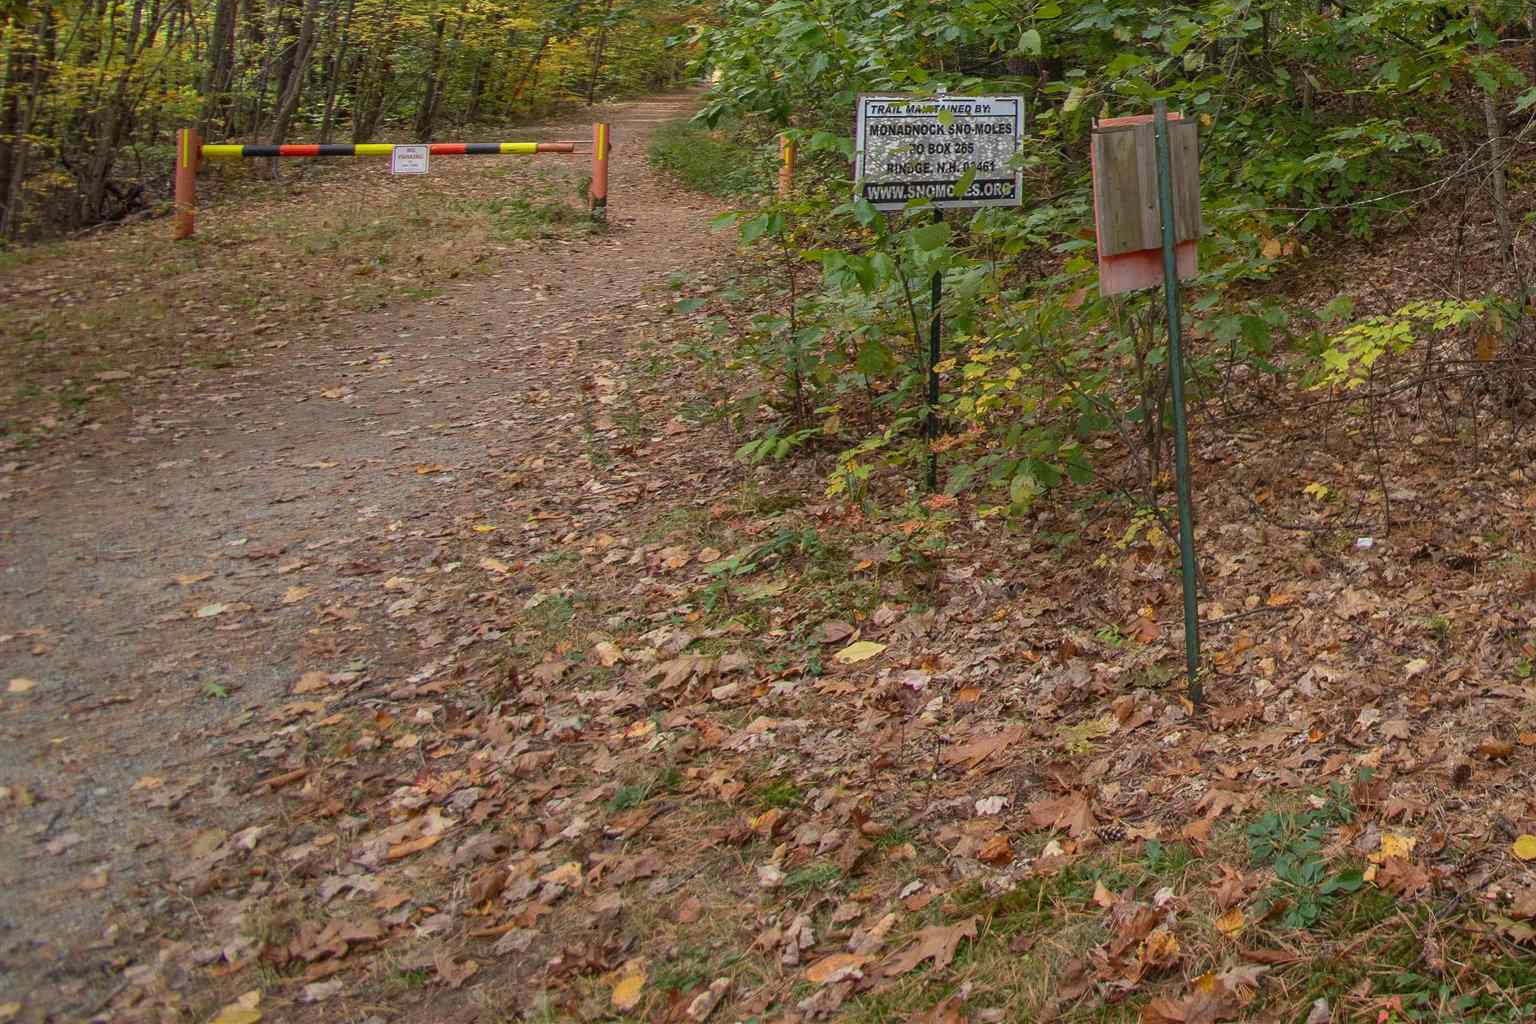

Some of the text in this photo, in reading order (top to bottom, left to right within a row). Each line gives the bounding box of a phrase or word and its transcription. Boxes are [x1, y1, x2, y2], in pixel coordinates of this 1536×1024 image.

[871, 104, 901, 114] TRAIL
[974, 104, 991, 114] BY:
[870, 123, 1012, 136] MONADNOCK SNO-MOLES
[928, 143, 951, 154] BOX
[955, 143, 974, 154] 265
